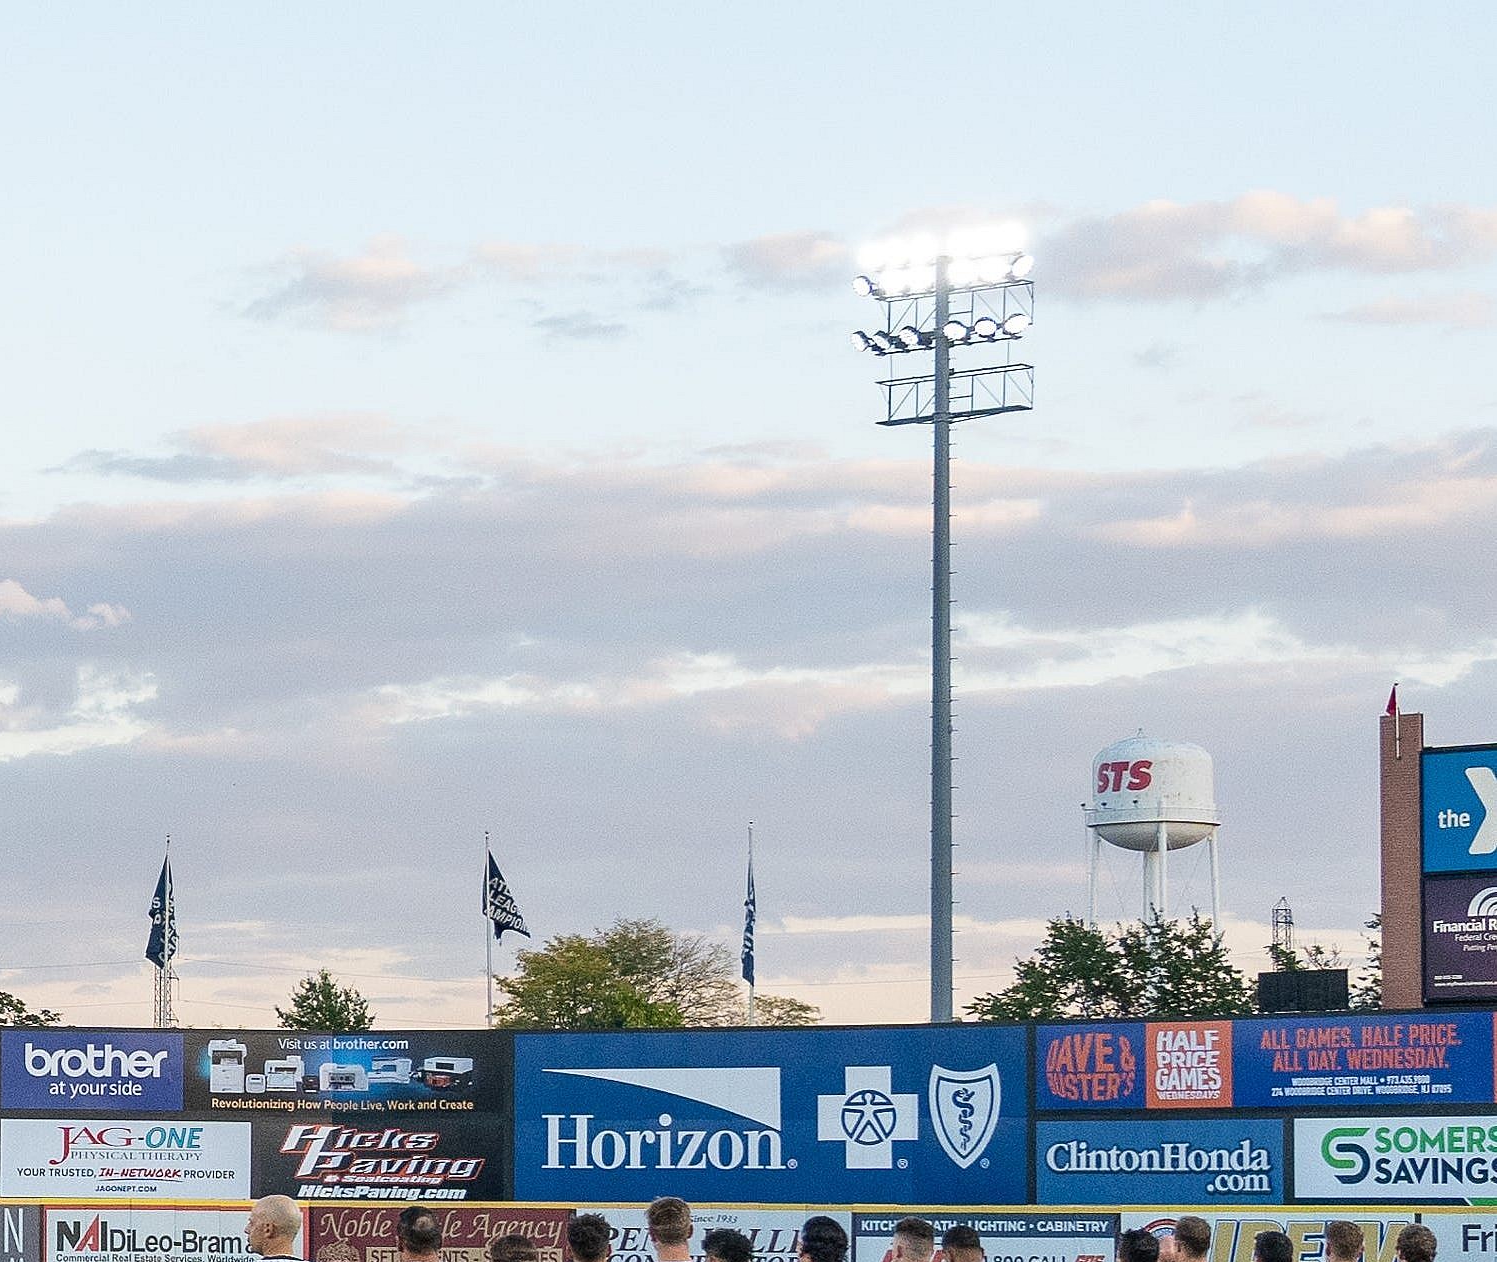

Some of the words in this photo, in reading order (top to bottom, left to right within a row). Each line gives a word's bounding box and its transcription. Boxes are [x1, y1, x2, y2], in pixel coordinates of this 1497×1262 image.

[1438, 809, 1470, 829] the
[278, 1038, 301, 1050] Visit
[303, 1040, 317, 1050] us
[319, 1040, 331, 1050] at
[333, 1038, 409, 1050] brother.com
[1156, 1030, 1219, 1051] HALF
[1261, 1030, 1290, 1050] ALL
[1296, 1027, 1355, 1048] GAMES.
[1361, 1026, 1403, 1047] HALF
[1409, 1024, 1463, 1046] PRICE.
[24, 1043, 167, 1078] brother
[1157, 1051, 1218, 1068] PRICE
[1273, 1051, 1303, 1072] ALL
[1307, 1050, 1342, 1071] DAY.
[1347, 1047, 1449, 1070] WEDNESDAY.
[49, 1082, 67, 1096] at
[69, 1083, 107, 1099] your
[109, 1080, 143, 1096] side
[1155, 1068, 1221, 1091] GAMES
[211, 1098, 295, 1112] Revolutionizing
[297, 1100, 321, 1110] How
[323, 1100, 357, 1112] People
[360, 1100, 385, 1111] Live,
[387, 1100, 415, 1110] Work
[417, 1100, 437, 1110] and
[439, 1100, 473, 1110] Create
[1157, 1091, 1220, 1100] WEDNESDAYS
[282, 1125, 438, 1151] Hicks
[541, 1113, 787, 1170] Horizon
[71, 1152, 137, 1160] PHYSICAL
[139, 1152, 203, 1161] THERAPY
[1045, 1139, 1271, 1172] ClintonHonda
[17, 1168, 45, 1177] YOUR
[49, 1168, 97, 1179] TRUSTED,
[98, 1168, 181, 1179] IN-NETWORK
[183, 1170, 235, 1180] PROVIDER
[297, 1184, 467, 1200] HicksPaving.com
[56, 1214, 108, 1252] NAI
[110, 1230, 241, 1252] DiLeo-Bram
[320, 1210, 393, 1239] Noble
[467, 1214, 563, 1248] Agency
